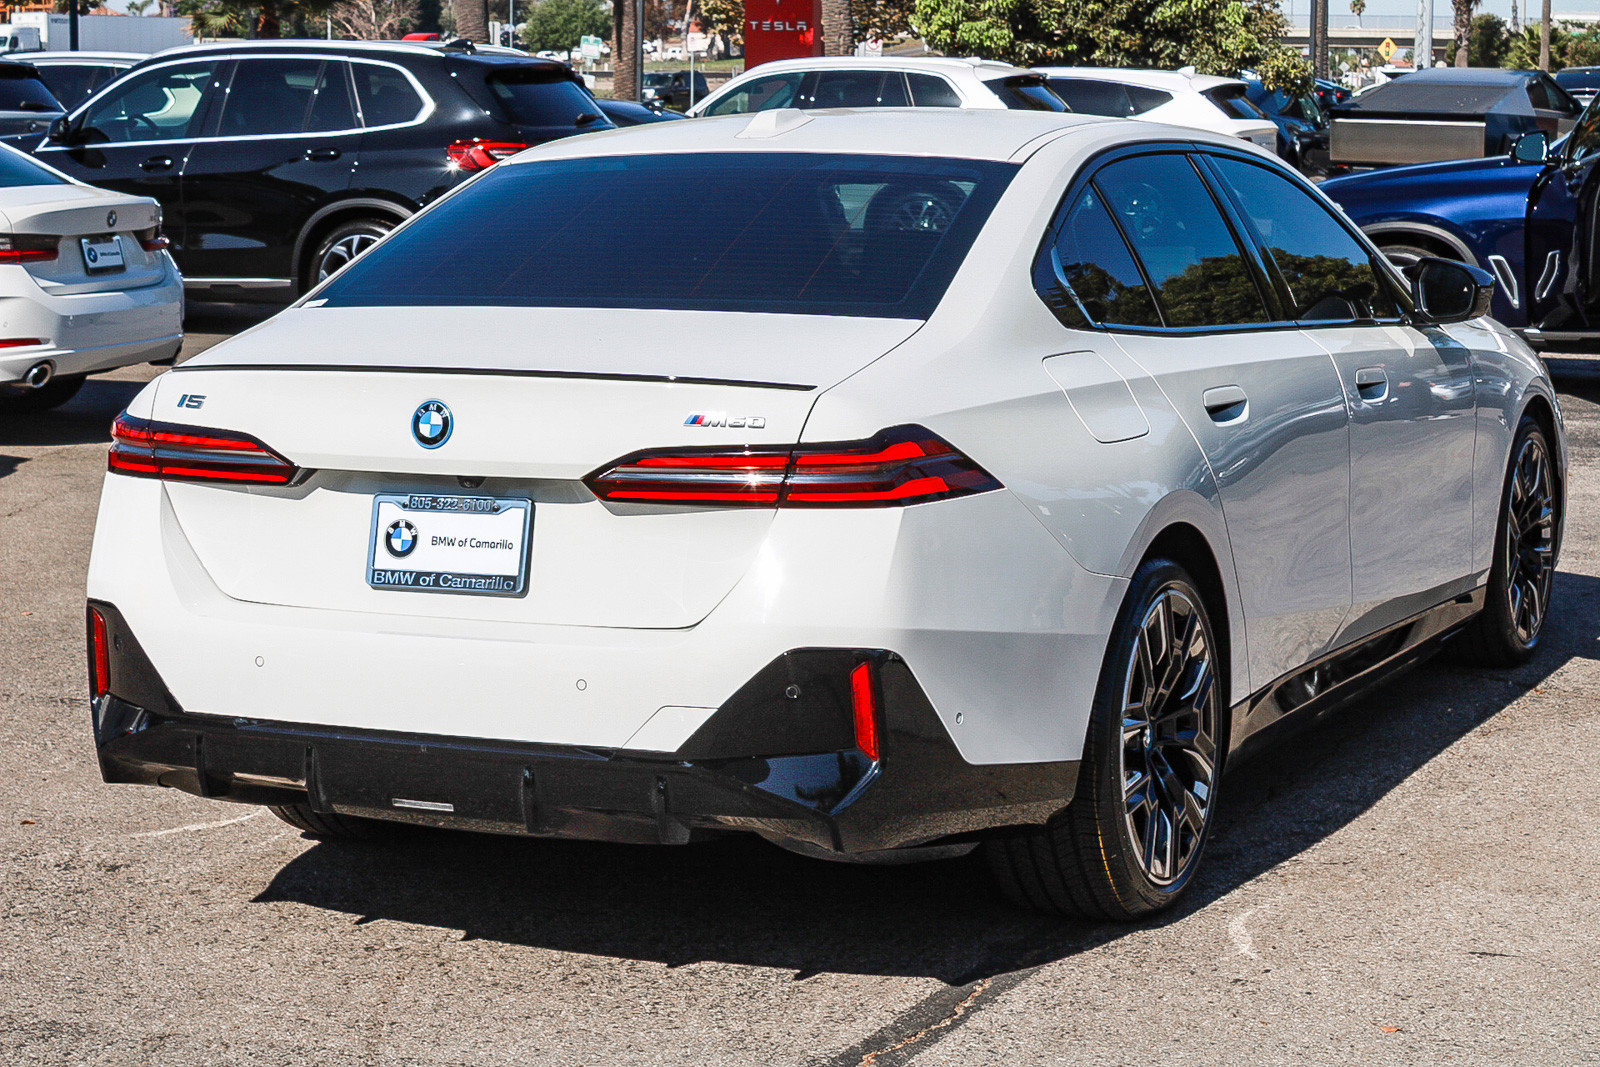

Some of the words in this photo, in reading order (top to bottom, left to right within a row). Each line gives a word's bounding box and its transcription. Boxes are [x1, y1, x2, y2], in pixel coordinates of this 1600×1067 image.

[749, 21, 807, 31] TESLA
[699, 414, 766, 429] M60
[410, 496, 492, 512] 805-322-6100
[431, 535, 457, 547] BMW
[457, 537, 469, 548] of
[469, 538, 514, 550] Camarillo
[373, 570, 416, 585] BMW
[419, 572, 436, 587] of
[439, 573, 514, 590] Camarillo
